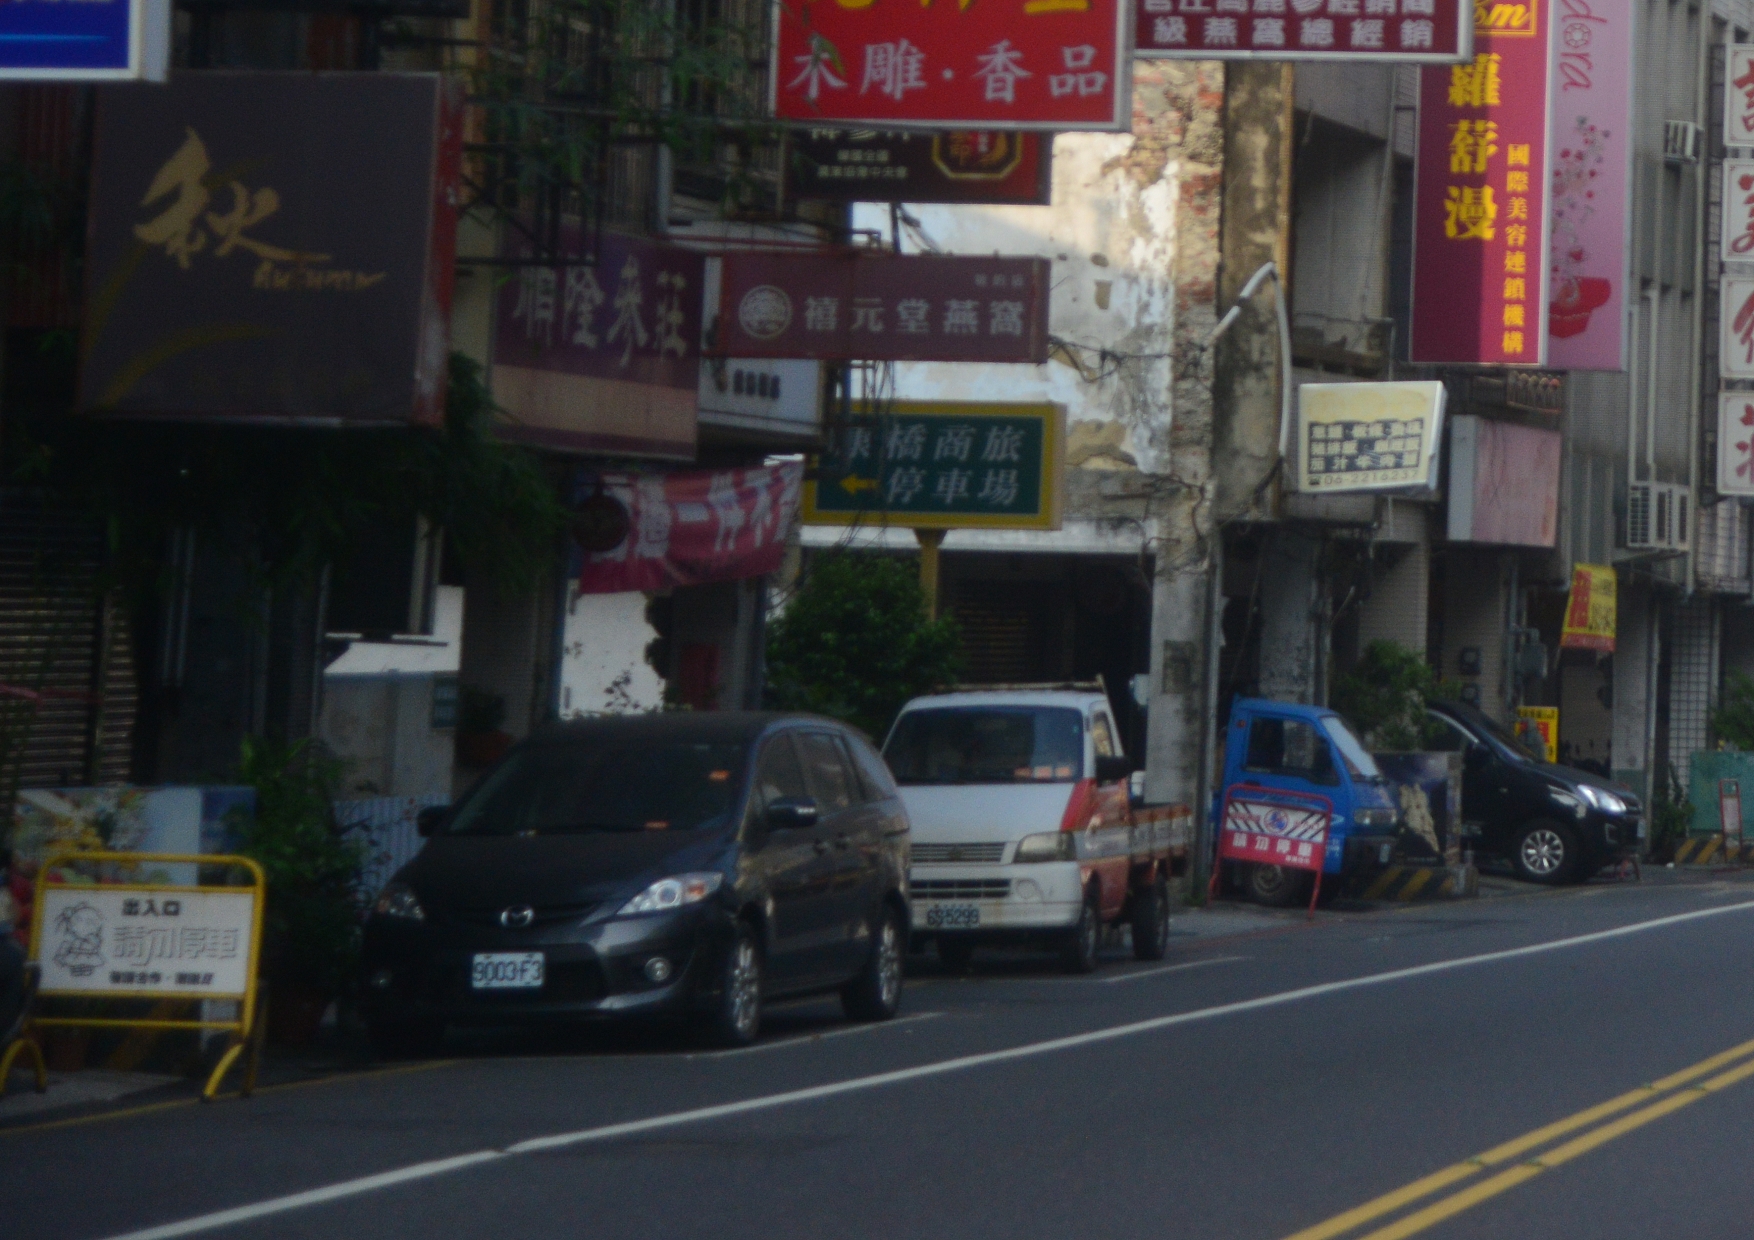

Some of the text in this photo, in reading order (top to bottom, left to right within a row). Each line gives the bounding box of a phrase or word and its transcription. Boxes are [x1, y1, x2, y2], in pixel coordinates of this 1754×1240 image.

[886, 467, 1021, 506] 停車場
[122, 899, 182, 917] 出入口
